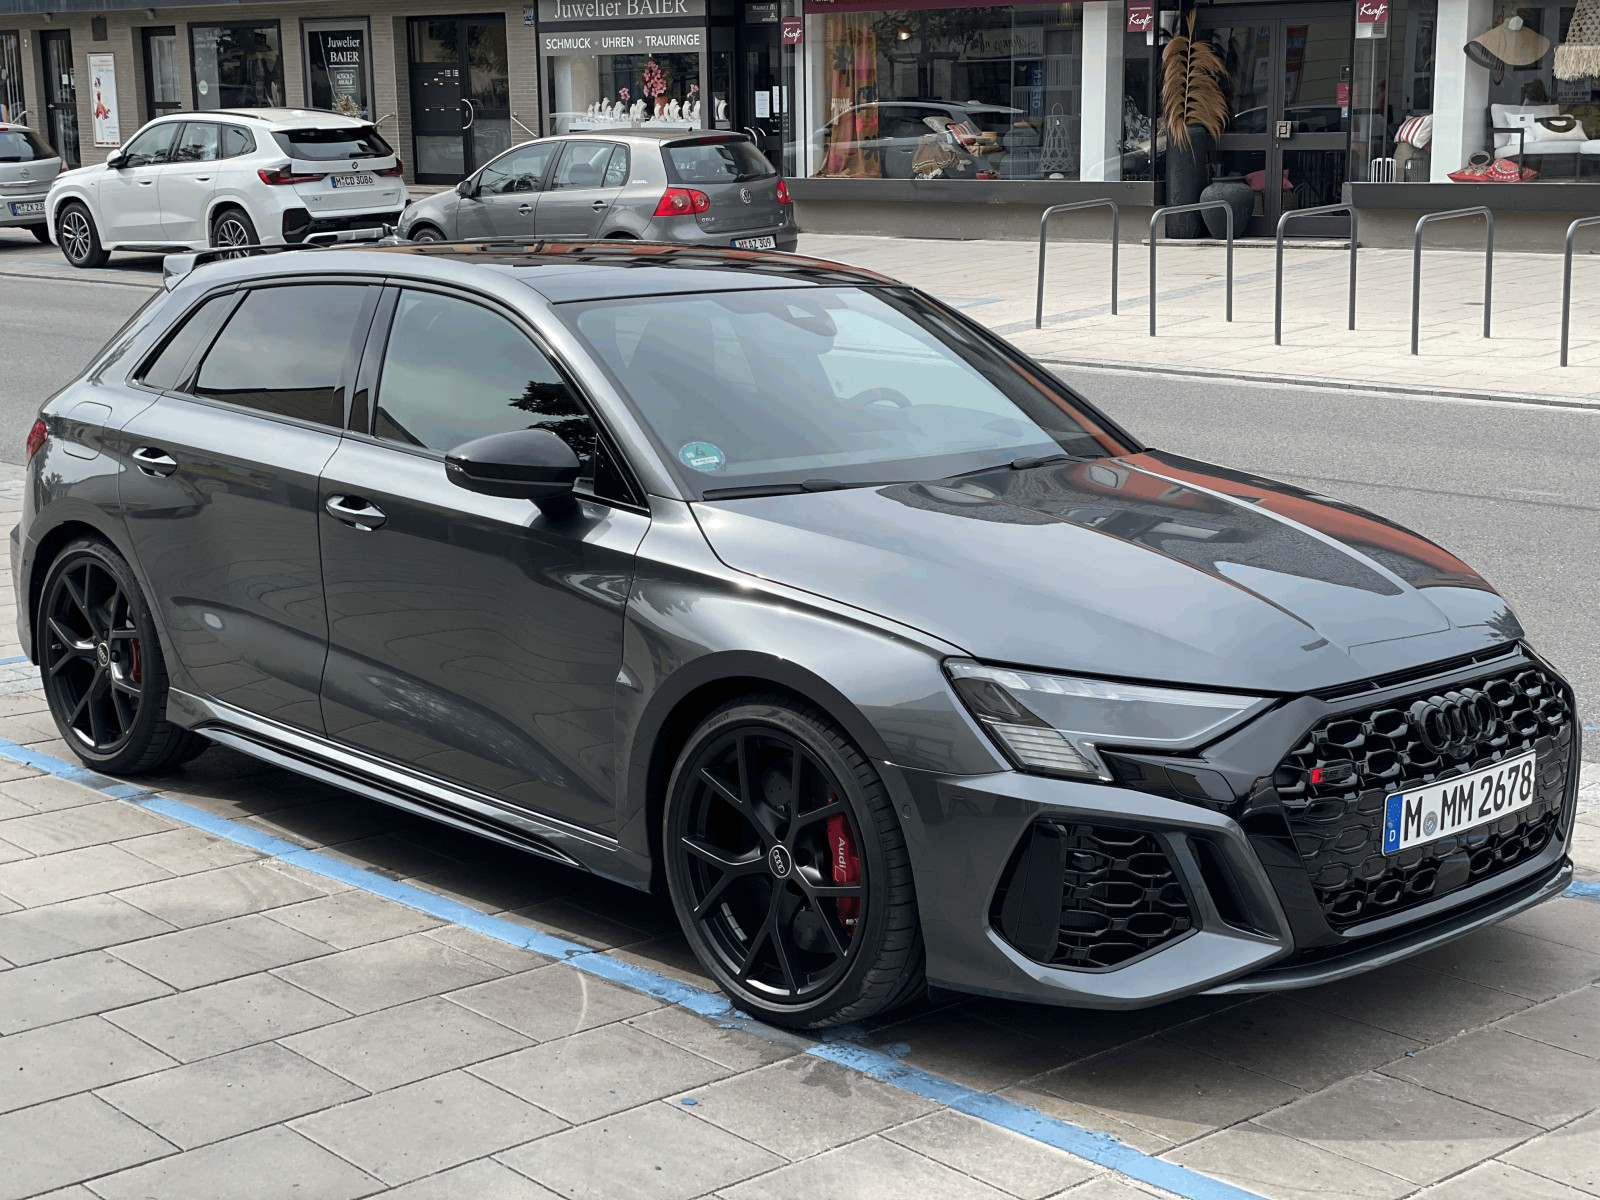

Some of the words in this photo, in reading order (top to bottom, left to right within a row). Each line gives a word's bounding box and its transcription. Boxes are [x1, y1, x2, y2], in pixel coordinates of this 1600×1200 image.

[554, 0, 622, 18] Juwelier
[626, 0, 688, 15] BAIER
[1360, 3, 1388, 20] Kraft
[1129, 13, 1153, 30] Kraft
[327, 36, 361, 48] Juwelier
[546, 37, 592, 50] SCHMUCK
[601, 36, 634, 48] UHREN
[645, 34, 700, 47] TRAURINGE
[783, 27, 803, 42] Kraft
[330, 51, 360, 62] BAIER
[345, 176, 355, 186] CD
[1403, 795, 1423, 842] M
[1440, 780, 1475, 831] MM
[1478, 760, 1532, 818] 2678
[1389, 830, 1396, 842] D
[838, 836, 847, 869] Audi
